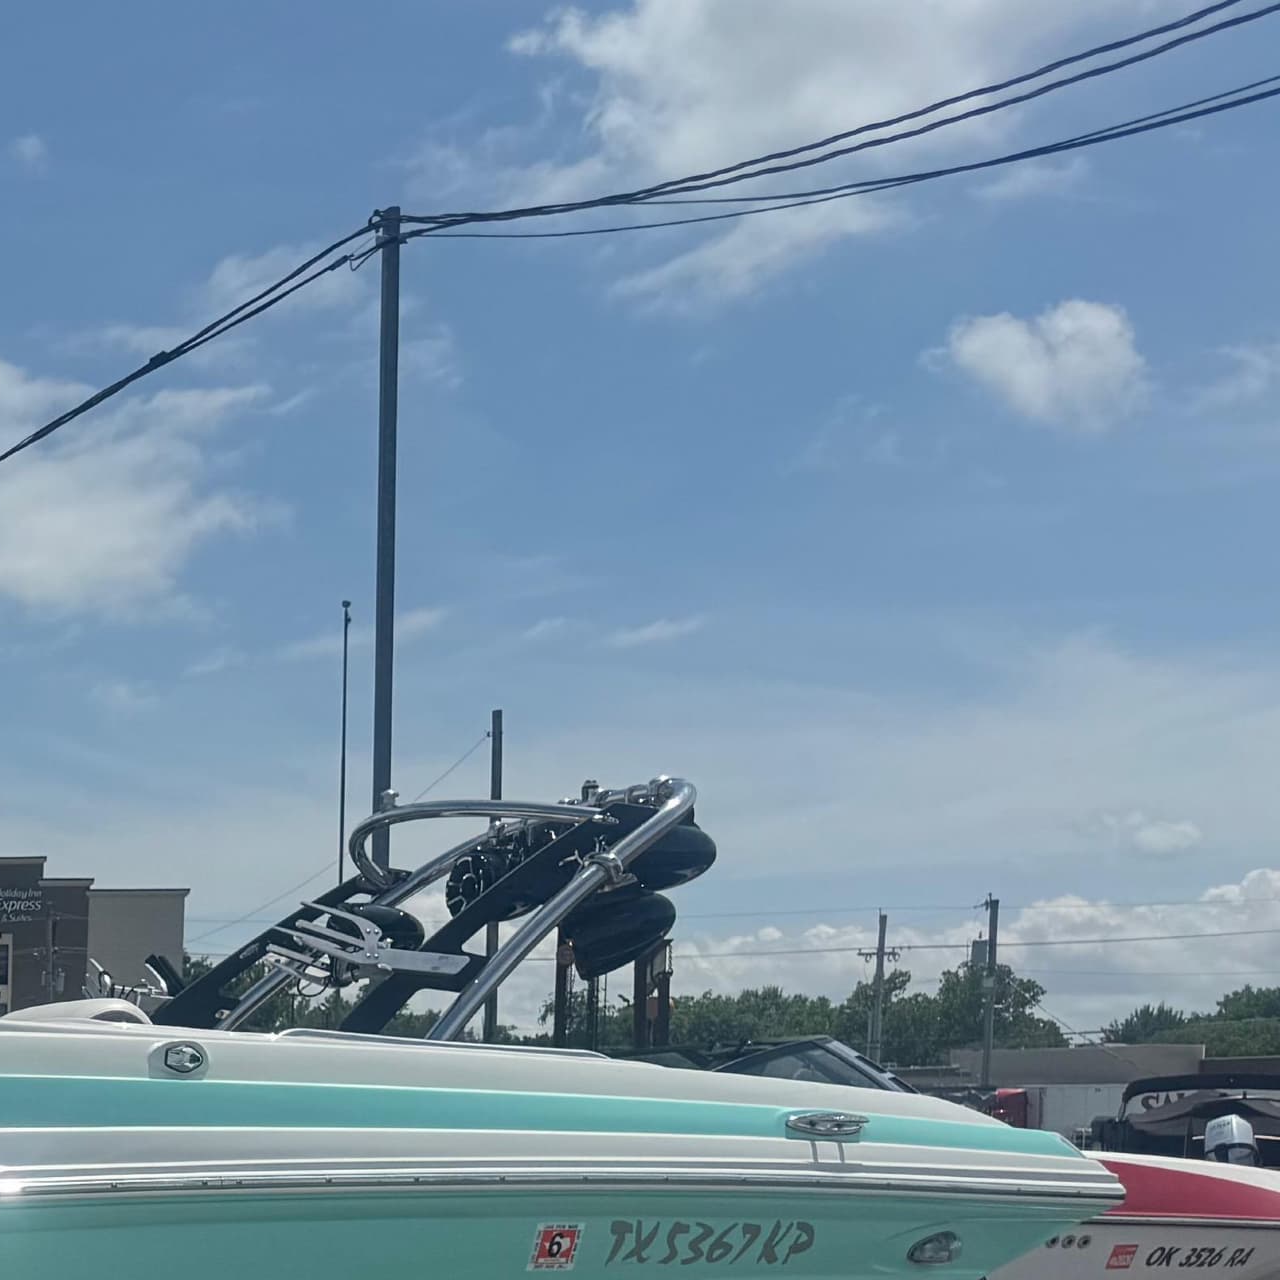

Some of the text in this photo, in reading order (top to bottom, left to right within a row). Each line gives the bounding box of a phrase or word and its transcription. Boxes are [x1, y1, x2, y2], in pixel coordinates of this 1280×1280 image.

[28, 888, 42, 898] Inn
[548, 1232, 564, 1258] 6
[1146, 1246, 1180, 1267] OK
[1178, 1247, 1227, 1268] 3526
[1224, 1247, 1255, 1267] RA
